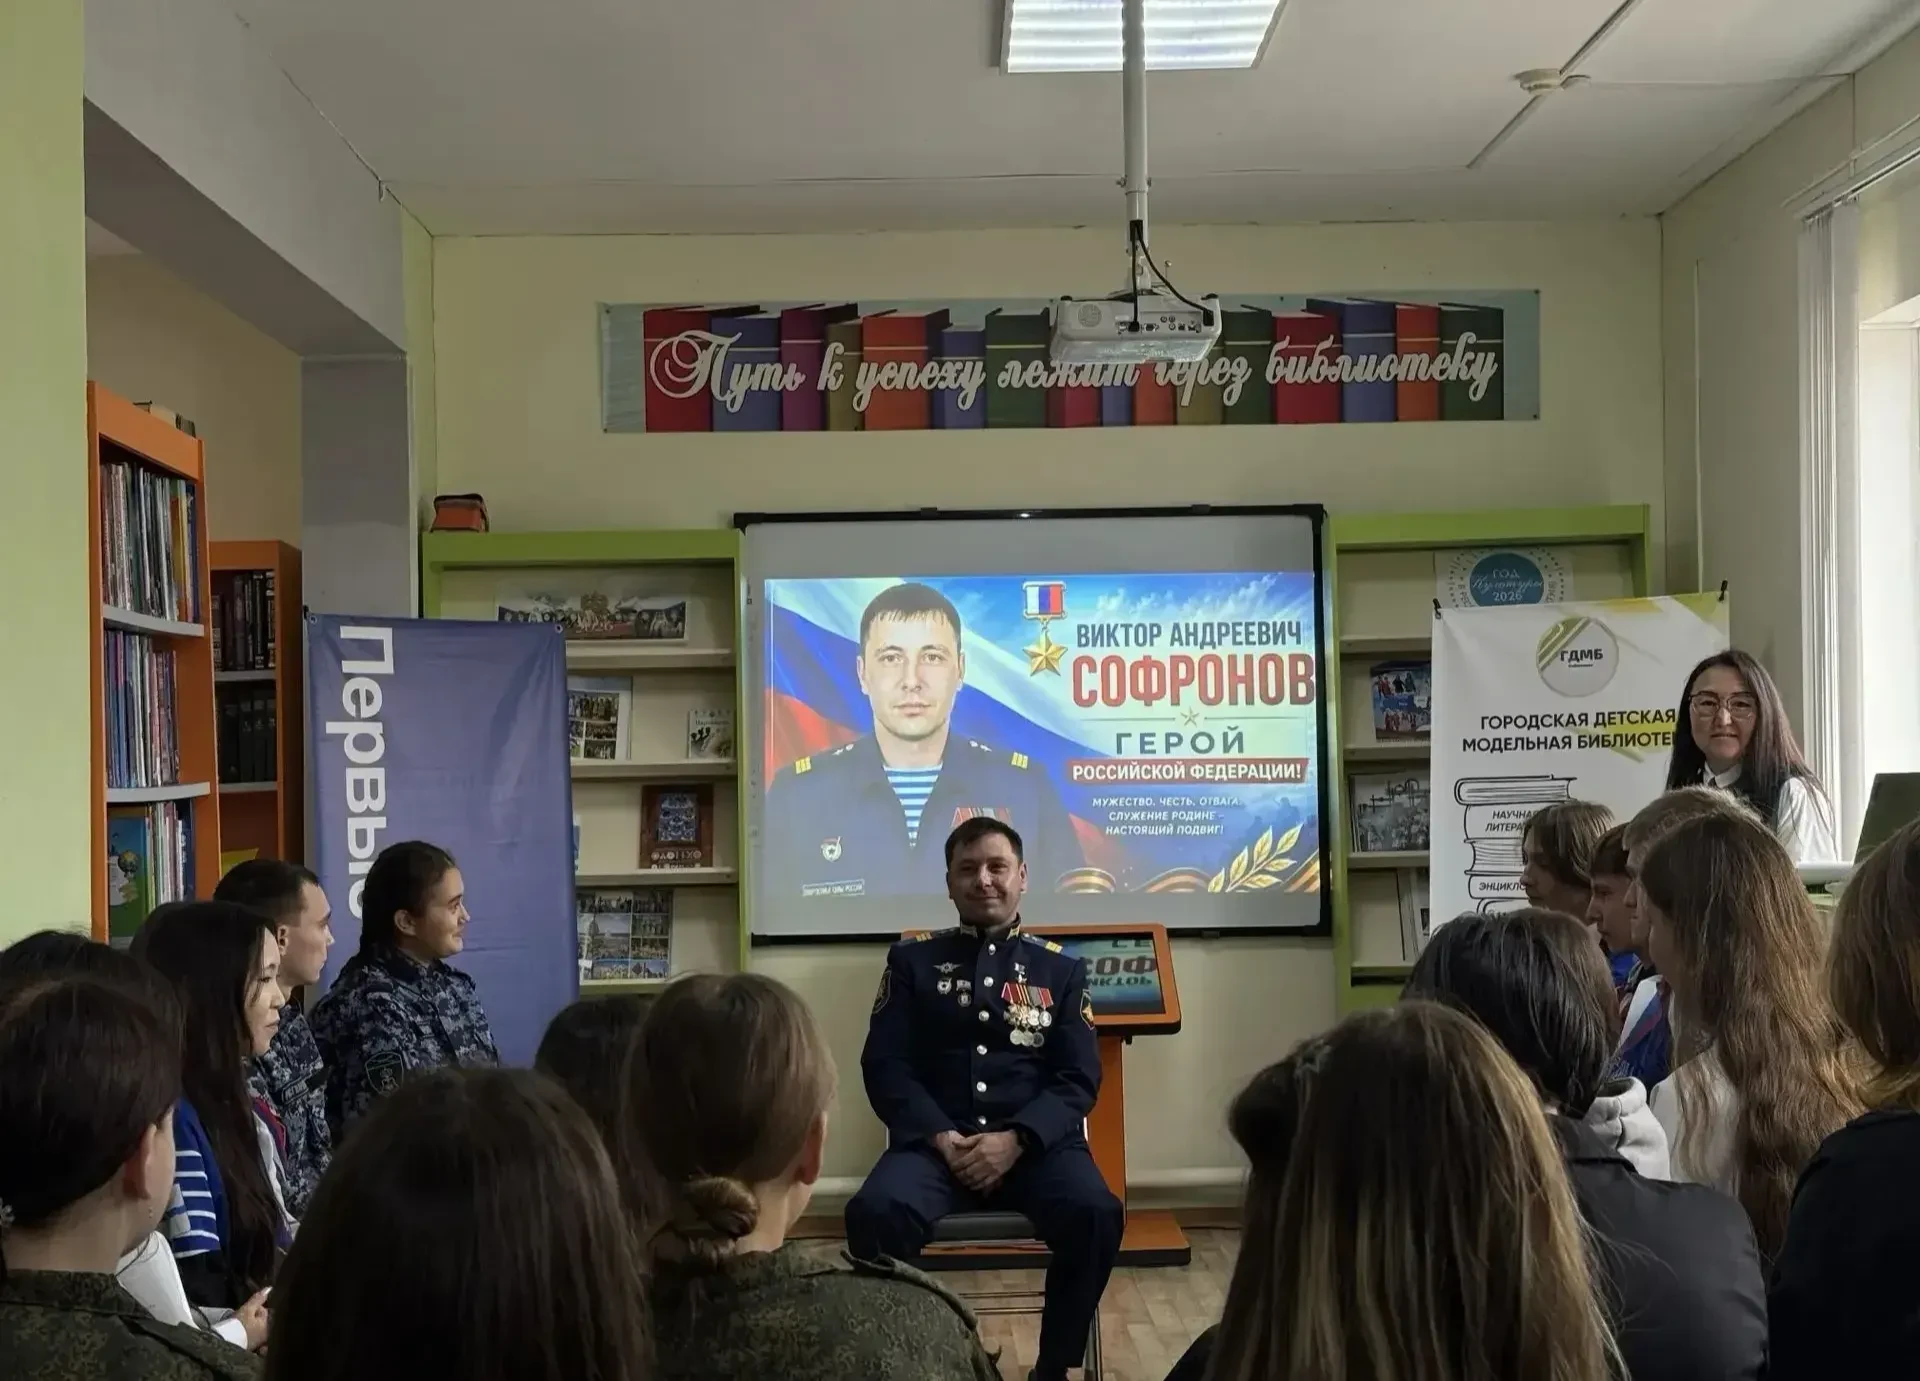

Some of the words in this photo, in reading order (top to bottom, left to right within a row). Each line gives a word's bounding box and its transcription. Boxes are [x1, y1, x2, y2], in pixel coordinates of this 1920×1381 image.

[649, 329, 806, 413] Путь
[817, 342, 845, 391] к
[853, 358, 987, 412] успеху
[997, 358, 1140, 389] лежит
[1153, 356, 1252, 407] через
[1265, 331, 1499, 403] библиотеку
[1492, 569, 1520, 578] ГОД
[1492, 591, 1523, 602] 2026
[1077, 622, 1162, 648] ВИКТОР
[1170, 621, 1302, 650] АНДРЕЕВИЧ
[1560, 648, 1604, 663] ГДМБ
[1072, 653, 1315, 708] СОФРОНОВ
[1480, 711, 1589, 731] ГОРОДСКАЯ
[1593, 708, 1676, 729] ДЕТСКАЯ
[1116, 726, 1245, 755] ГЕРОЙ
[1462, 735, 1572, 754] МОДЕЛЬНАЯ
[1072, 761, 1186, 781] РОССИЙСКОЙ
[1190, 763, 1302, 782] ФЕДЕРАЦИИ!
[1108, 811, 1169, 821] СЛУЖЕНИЕ
[1171, 810, 1216, 821] РОДИНЕ
[1105, 823, 1174, 836] НАСТОЯЩИЙ
[1176, 824, 1224, 836] ПОДВИГ!
[1485, 822, 1526, 832] ЛИТЕРА
